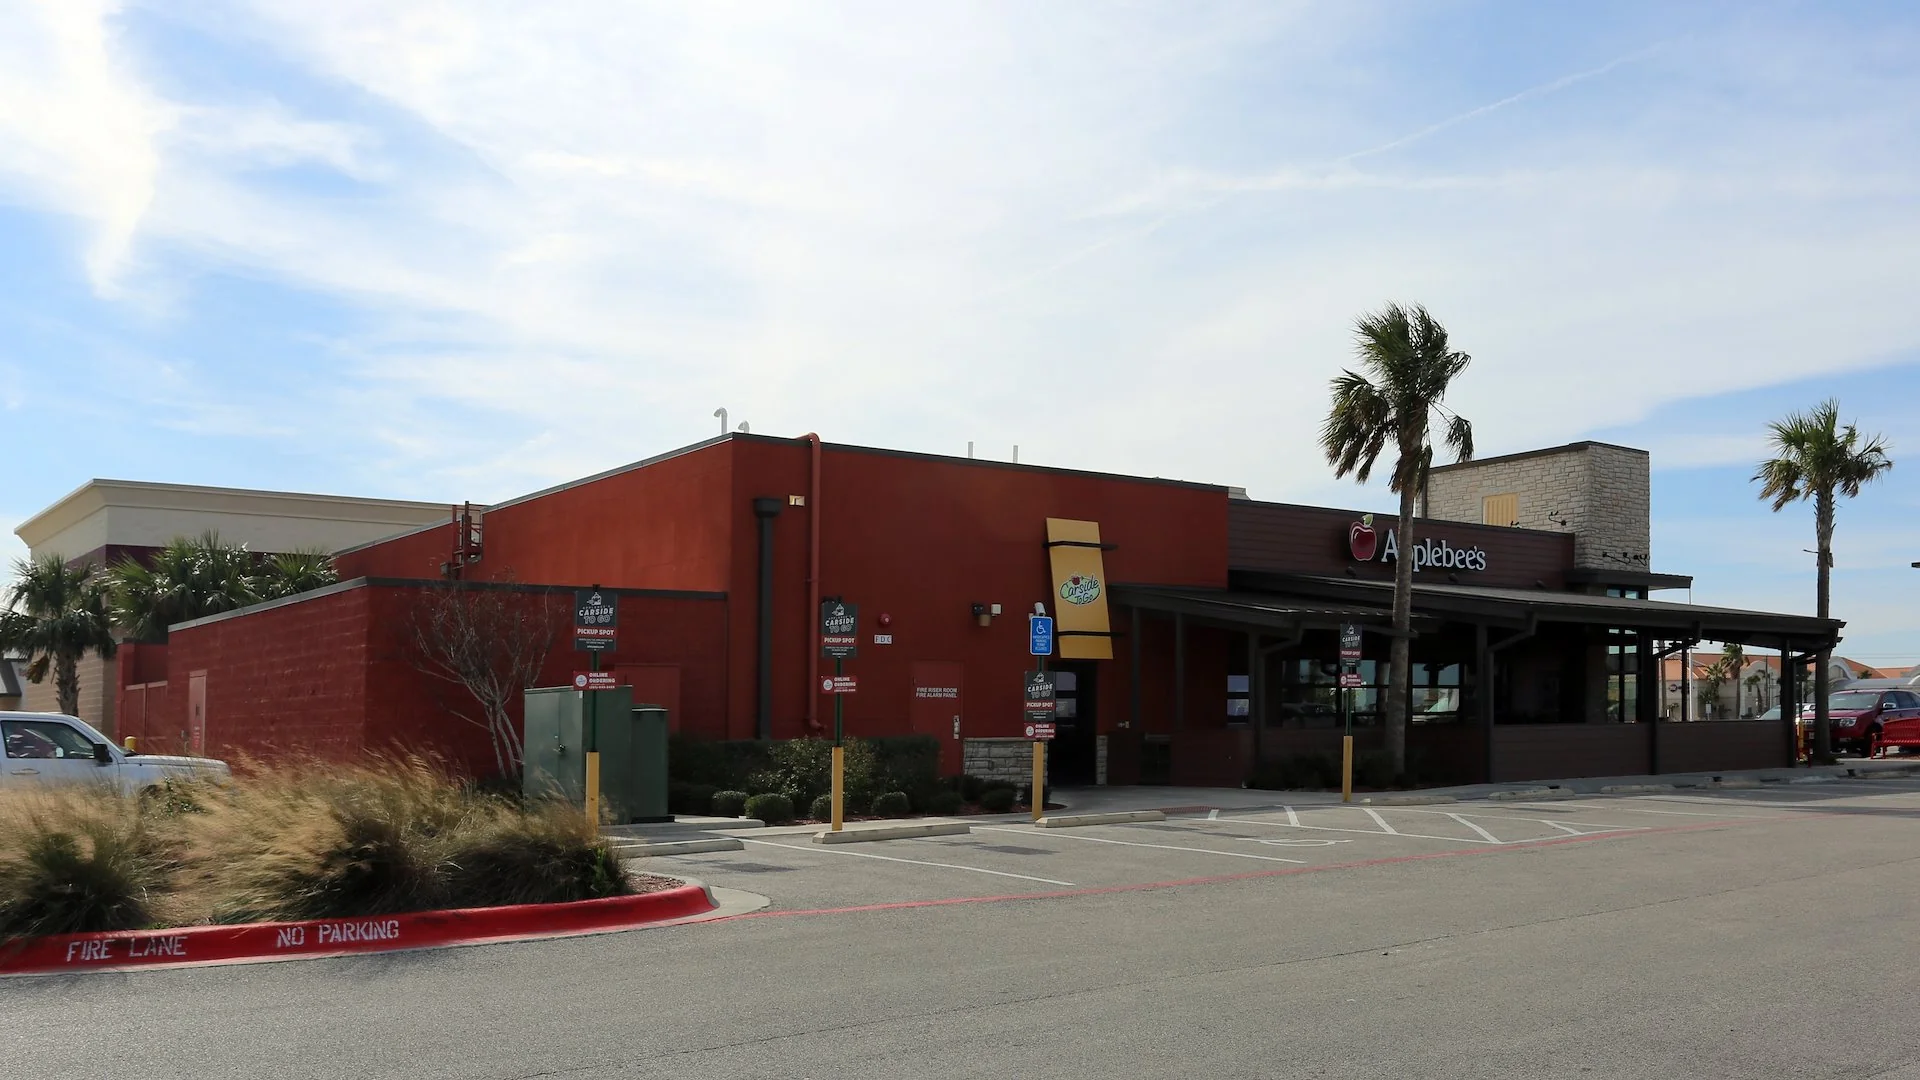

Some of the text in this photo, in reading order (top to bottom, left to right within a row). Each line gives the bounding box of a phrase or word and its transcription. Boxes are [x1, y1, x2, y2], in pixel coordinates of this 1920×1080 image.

[1381, 528, 1486, 572] Aplebee's
[1060, 574, 1099, 599] Carside
[578, 607, 614, 617] CARSIDE
[583, 614, 611, 624] TO GO
[825, 617, 855, 627] CARSIDE
[1027, 683, 1053, 692] CARSIDE
[276, 920, 400, 948] NO PARKING
[66, 936, 189, 962] FIRE LANE
